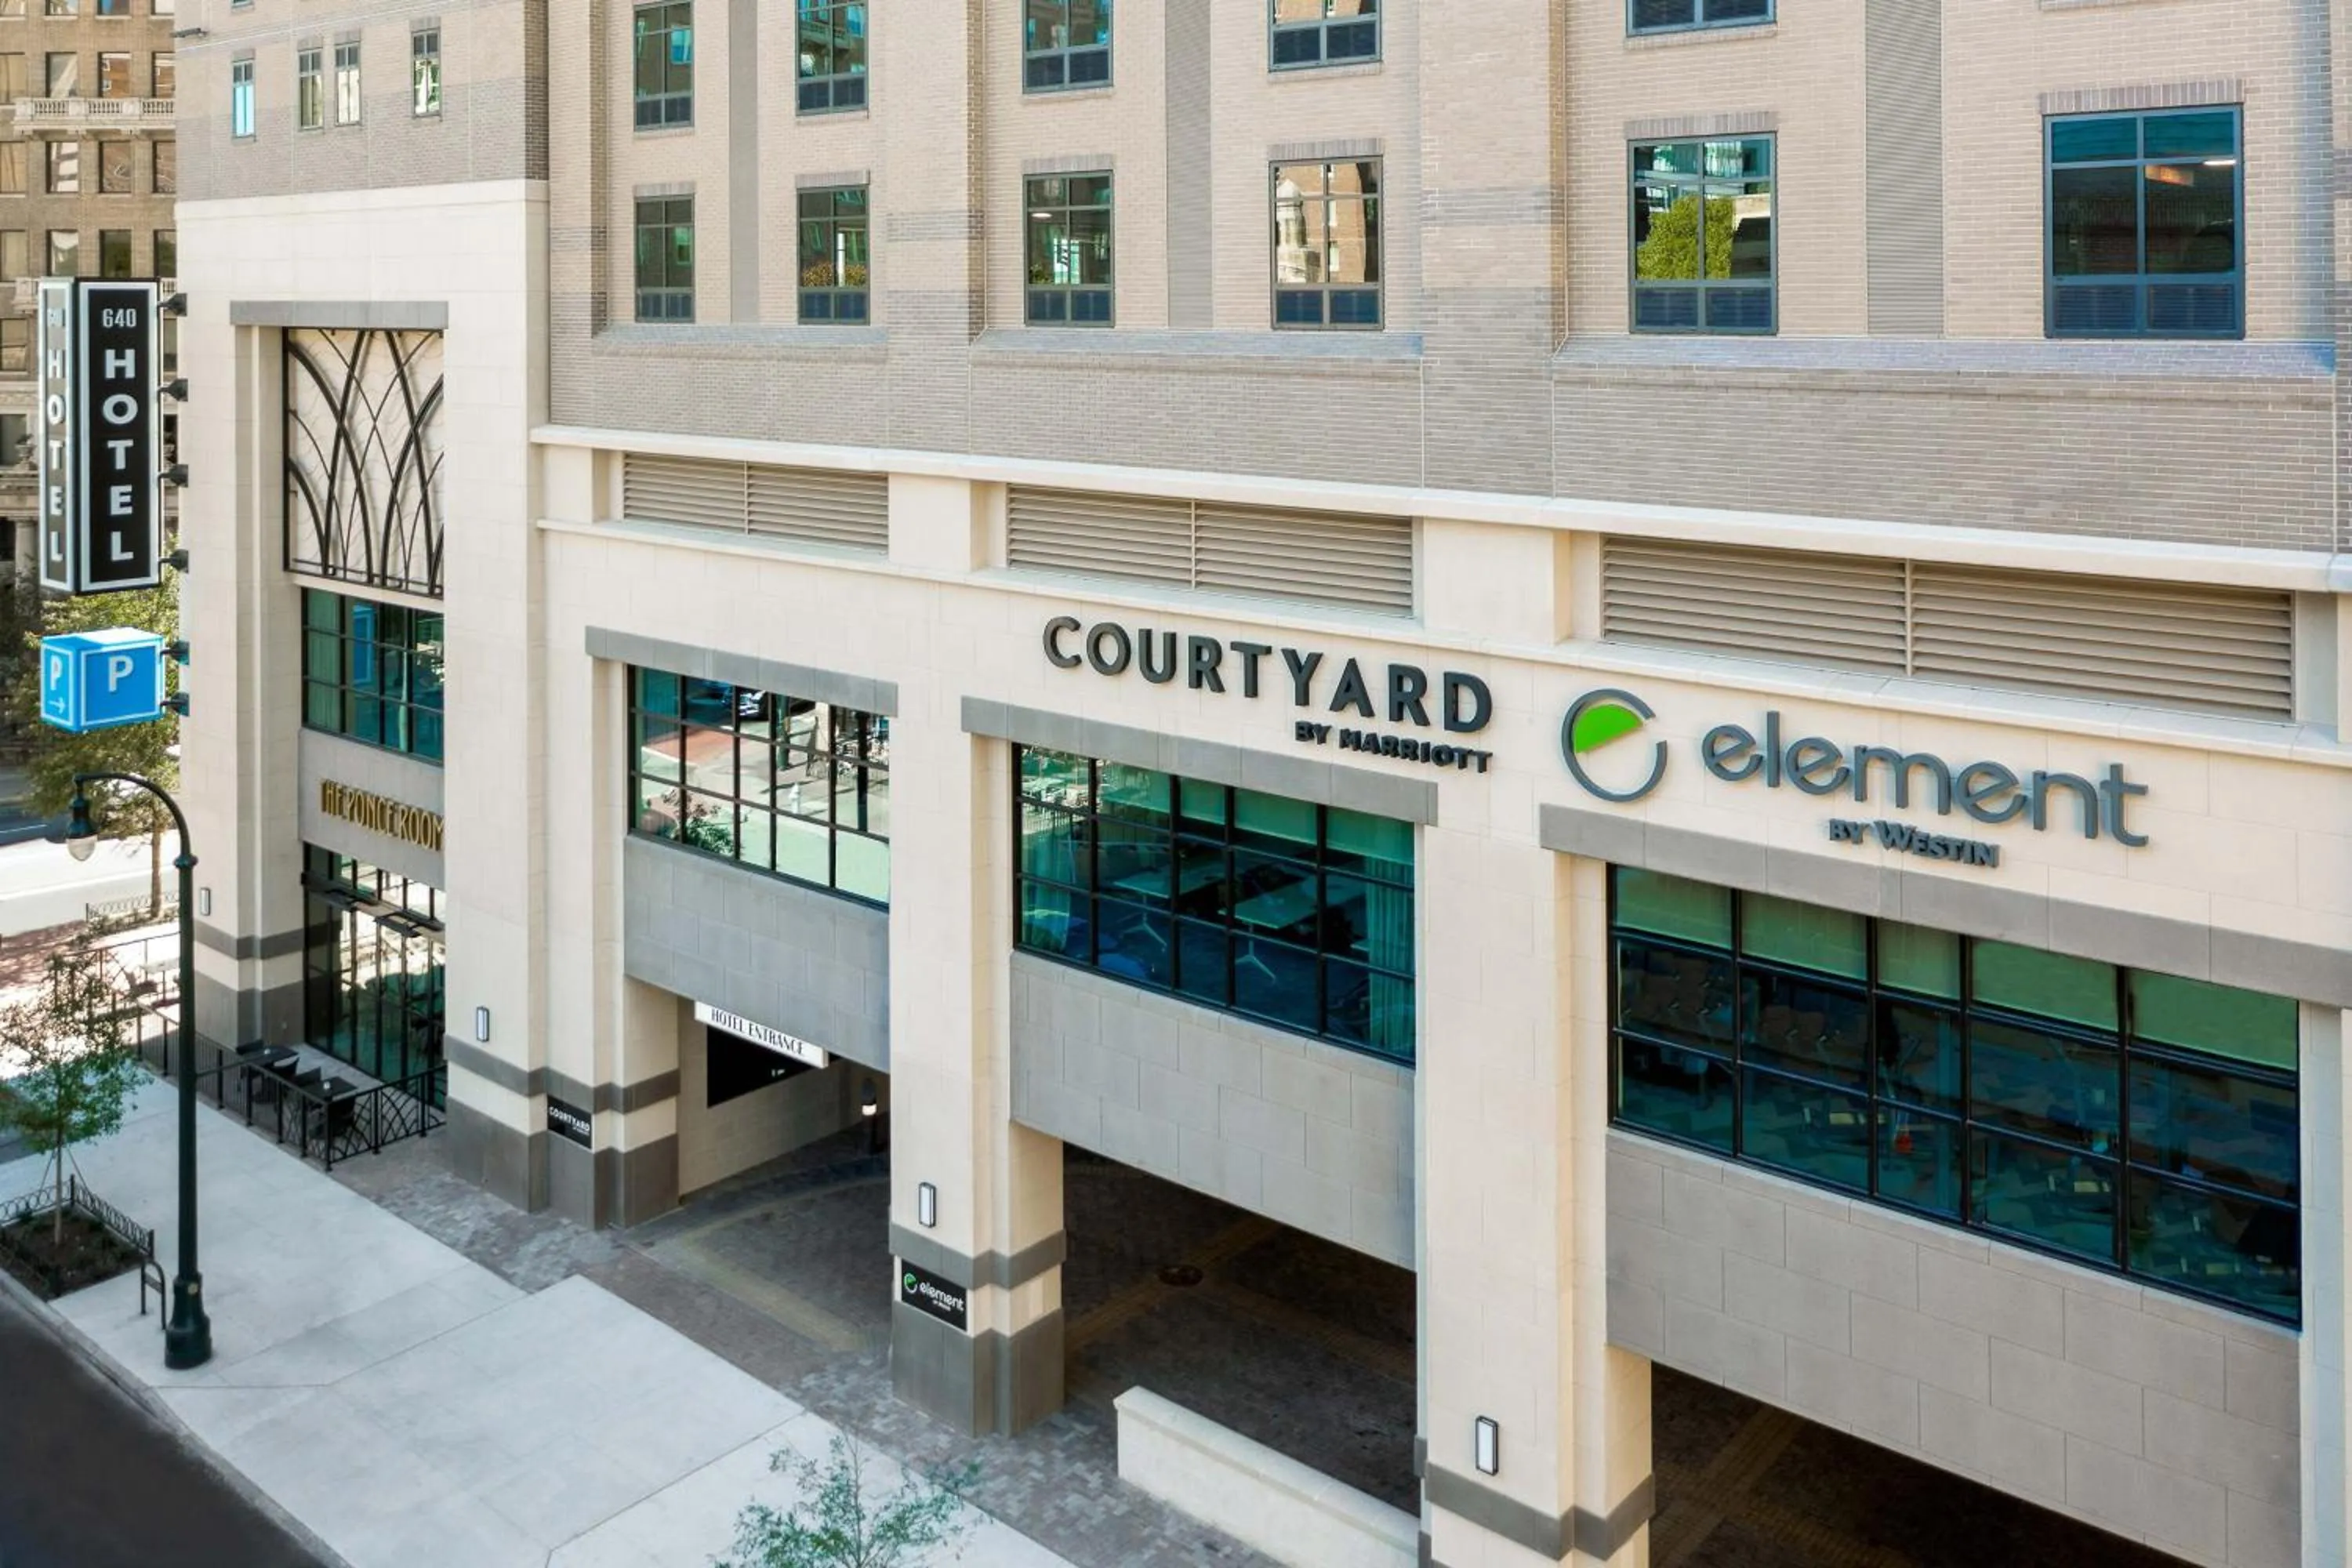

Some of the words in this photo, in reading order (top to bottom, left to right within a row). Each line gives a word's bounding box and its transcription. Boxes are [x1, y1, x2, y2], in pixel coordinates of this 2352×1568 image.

[103, 308, 137, 328] 640
[47, 349, 64, 563] HOTEL
[103, 348, 139, 561] HOTEL
[50, 655, 63, 691] P
[108, 655, 134, 692] P
[1043, 615, 1493, 733] COURTYARD
[1295, 720, 1332, 745] BY
[1339, 728, 1493, 773] MARRIOTT
[1702, 710, 2149, 848] element
[345, 786, 396, 837] PONCE
[397, 802, 445, 851] ROOM
[1830, 818, 1870, 844] BY
[711, 1008, 744, 1033] HOTEL
[749, 1022, 804, 1055] ENTRANCE
[550, 1106, 590, 1131] COURTYARD
[919, 1282, 964, 1309] element
